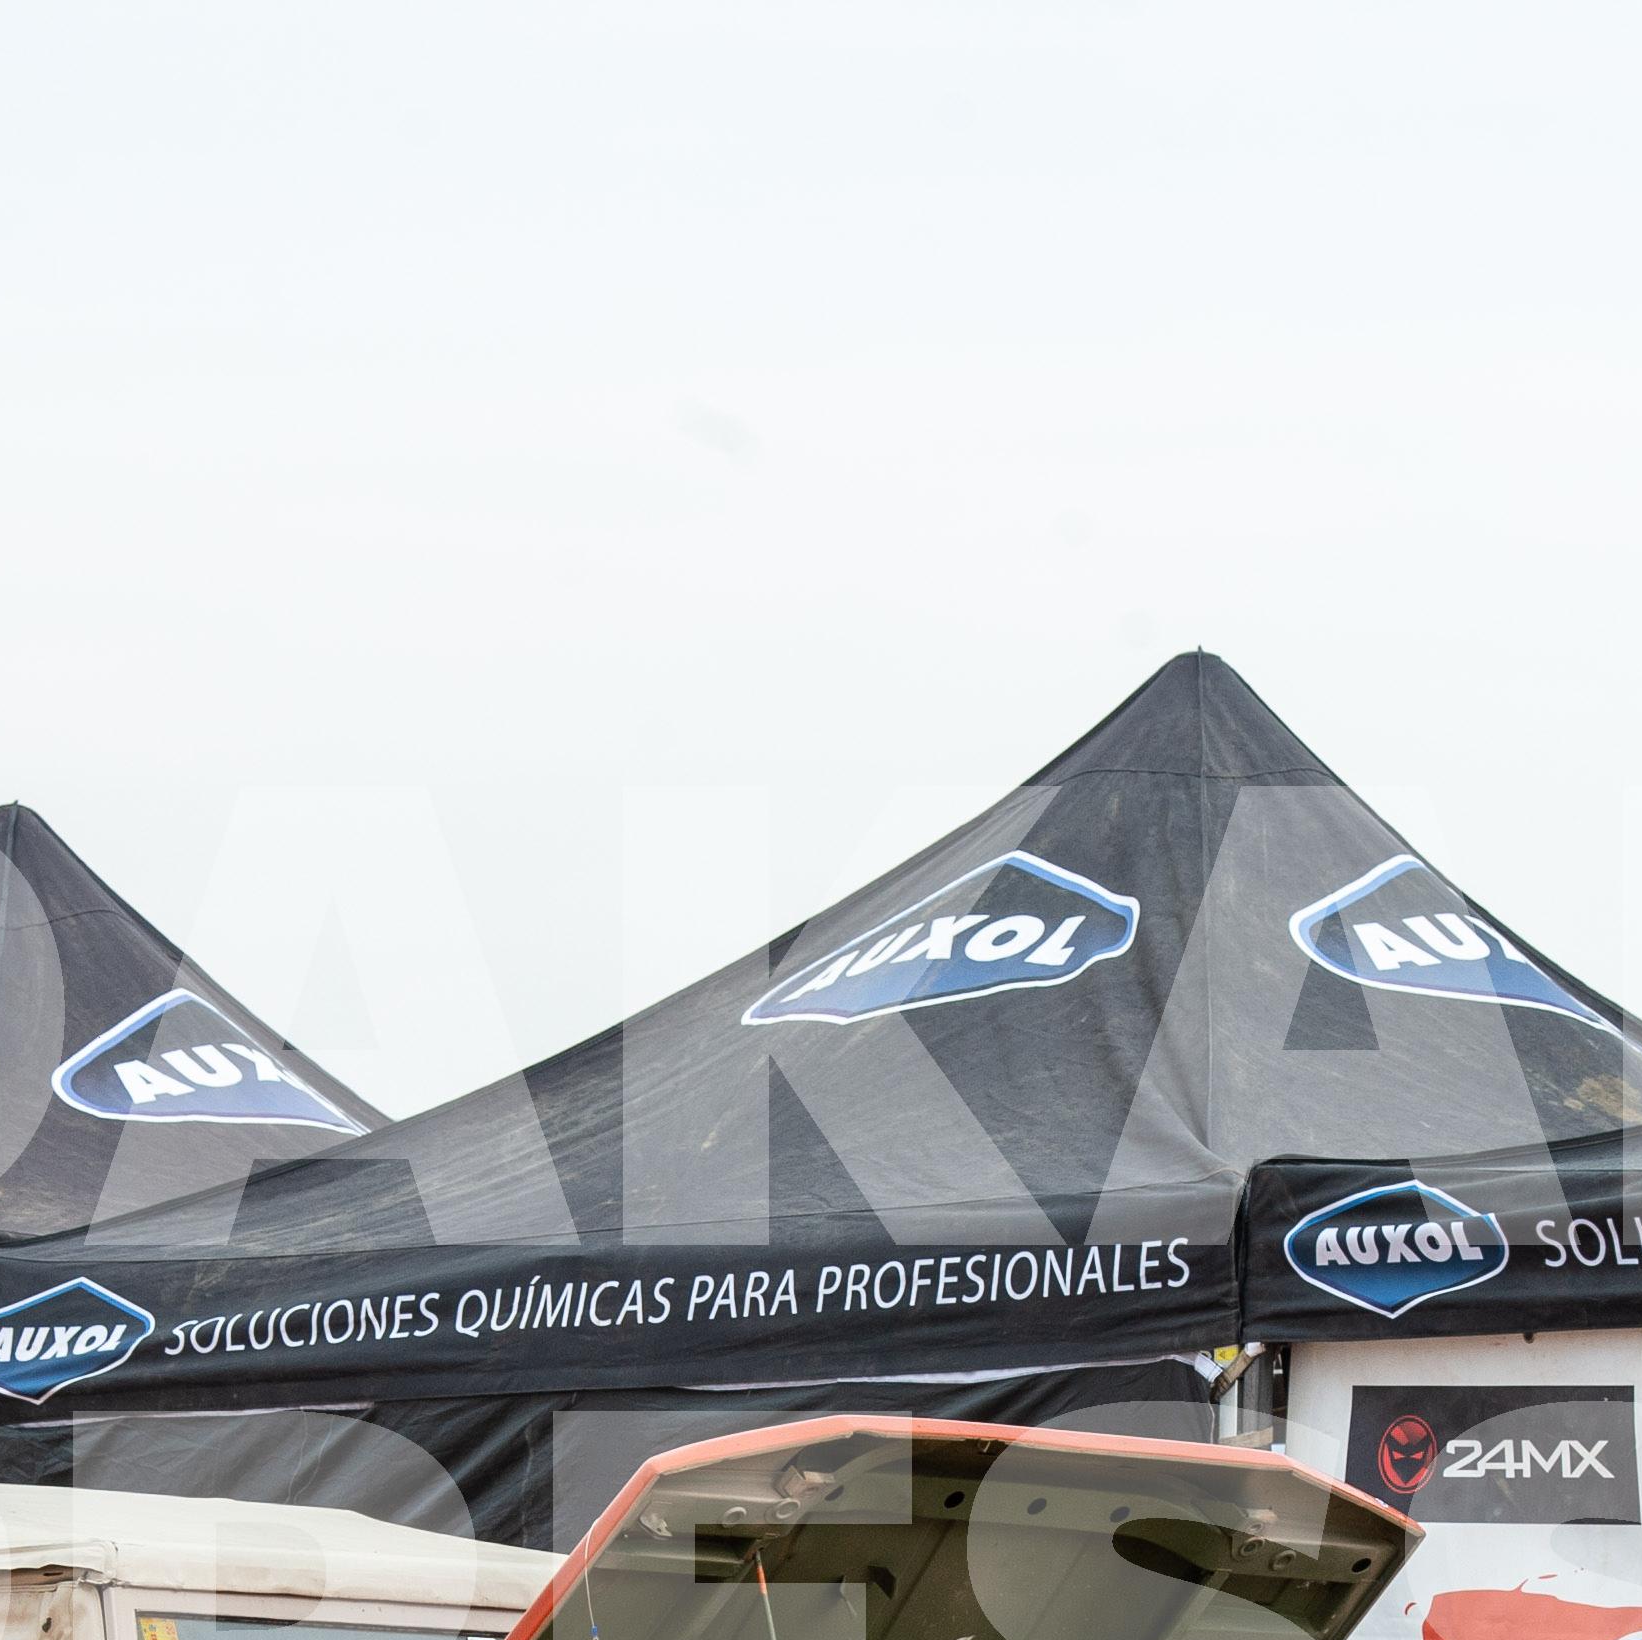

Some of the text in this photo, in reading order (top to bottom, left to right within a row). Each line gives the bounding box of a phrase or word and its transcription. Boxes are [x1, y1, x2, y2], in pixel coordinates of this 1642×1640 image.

[787, 914, 1087, 1000] AUXOL
[114, 1043, 292, 1104] AUX
[1315, 1220, 1486, 1267] AUXOL
[165, 1291, 440, 1356] SOLUCIONES
[455, 1275, 674, 1336] QUÍMICAS
[686, 1269, 798, 1321] PARA
[816, 1237, 1189, 1314] PROFESIONALES
[1443, 1439, 1614, 1479] 24MX
